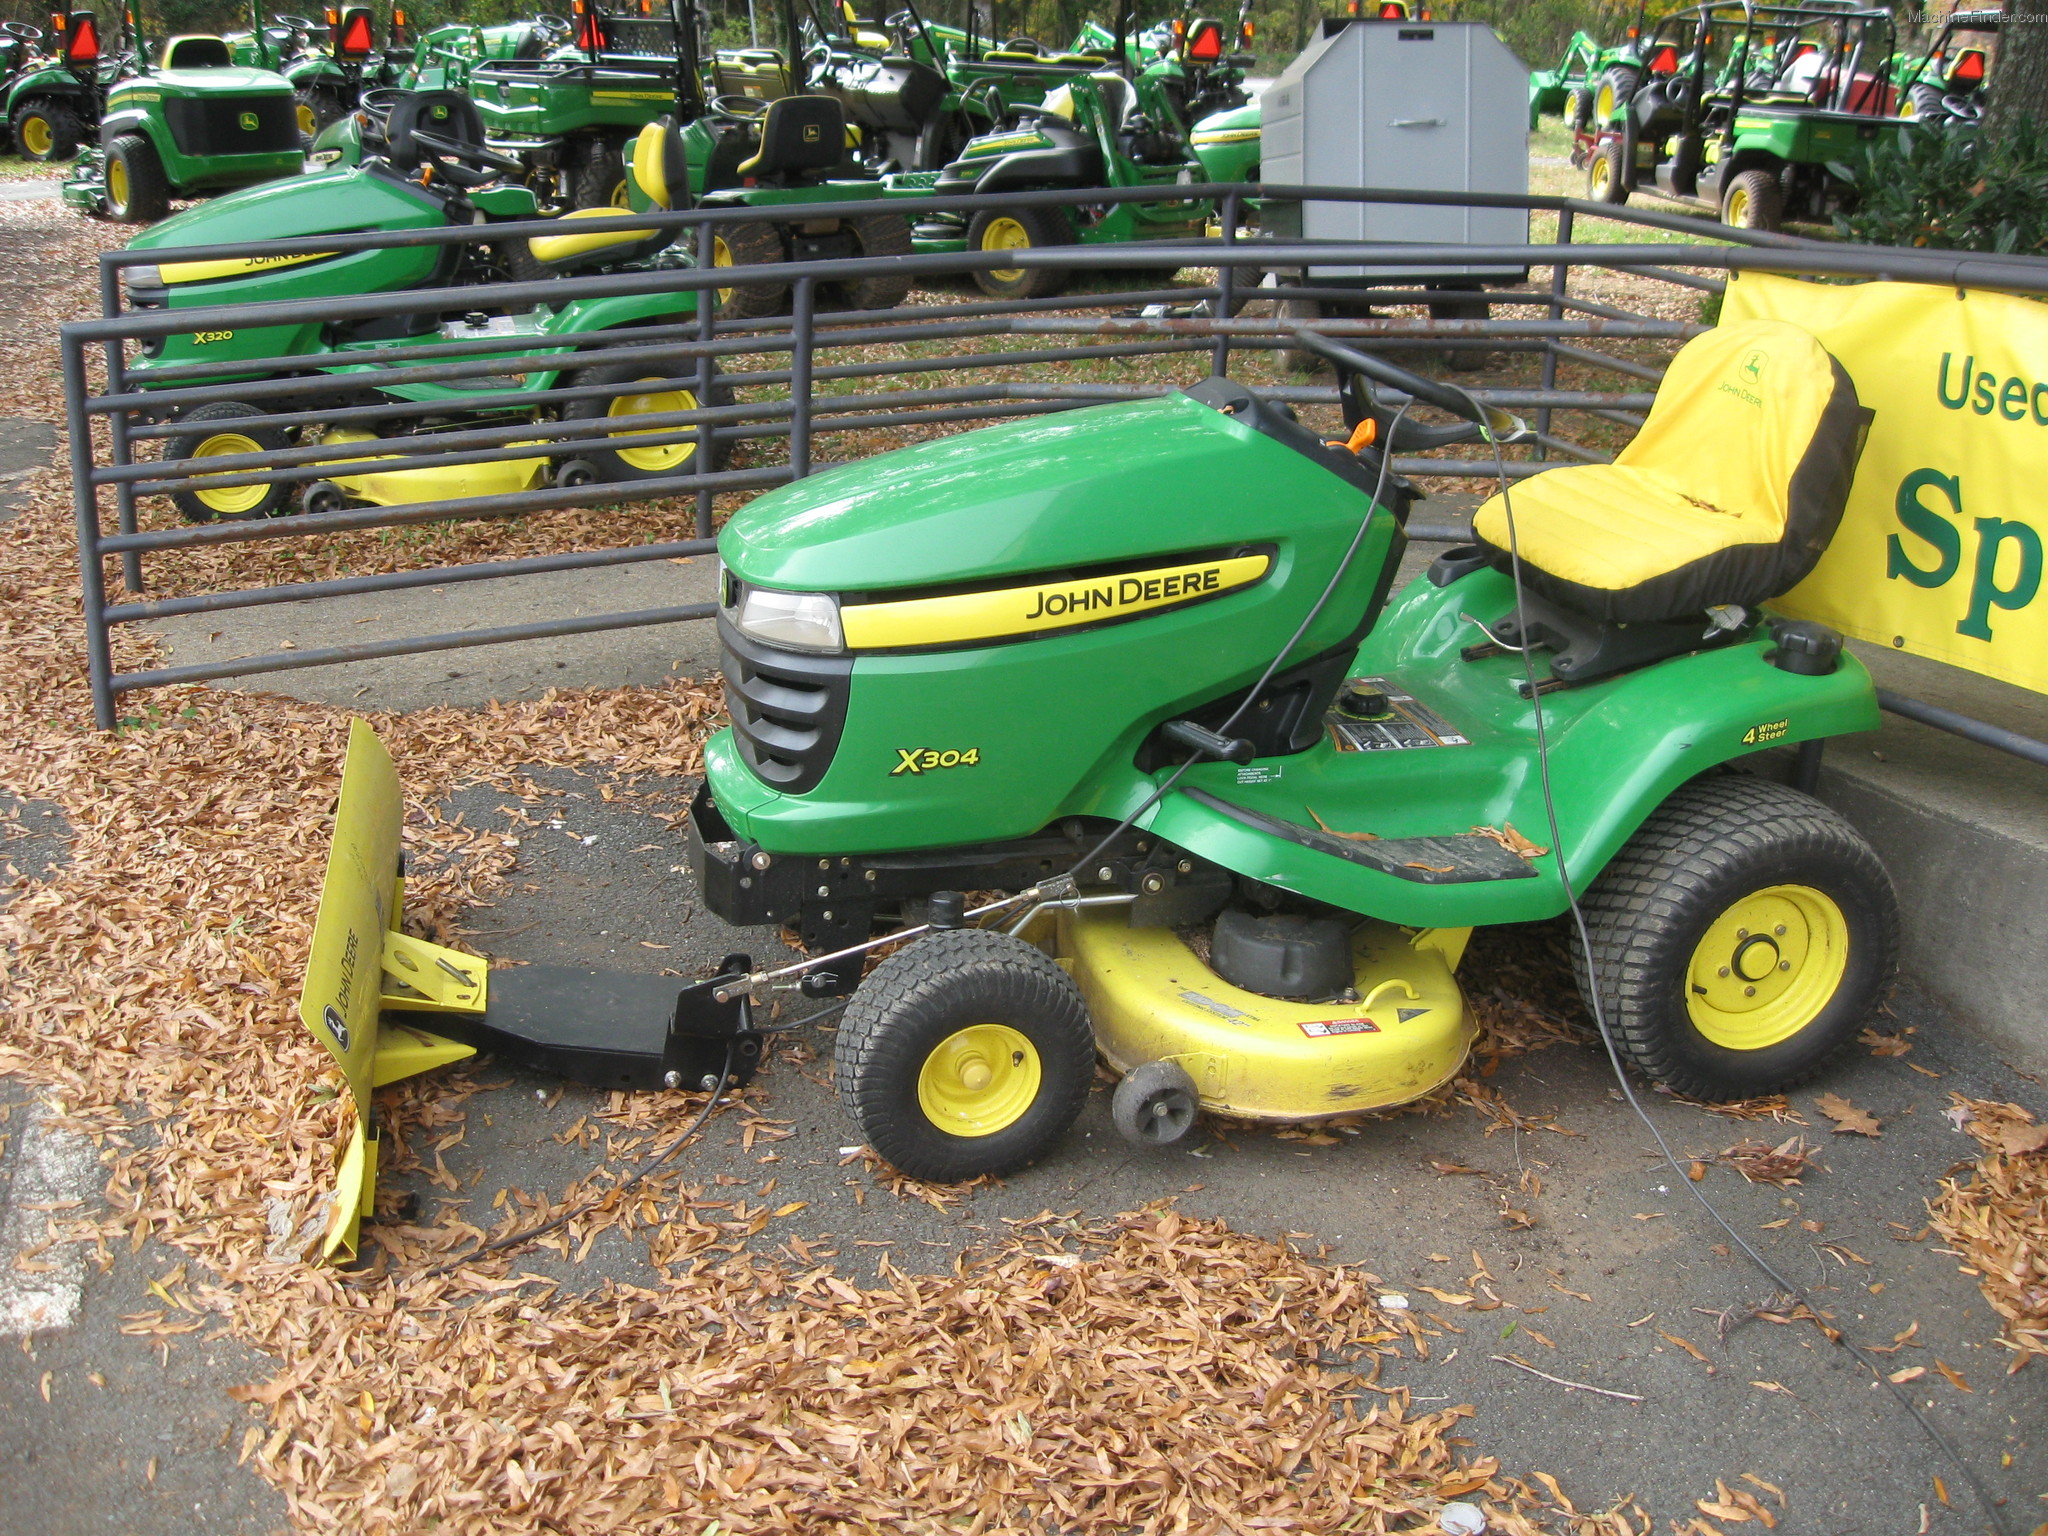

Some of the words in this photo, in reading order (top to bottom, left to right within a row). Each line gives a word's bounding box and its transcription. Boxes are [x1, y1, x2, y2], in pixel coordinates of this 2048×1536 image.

[193, 330, 234, 345] X320
[1717, 381, 1740, 397] JOHN
[1887, 467, 2044, 642] Sp
[1026, 586, 1113, 619] JOHN
[1119, 568, 1220, 605] DEERE
[1741, 727, 1756, 745] 4
[1758, 718, 1788, 734] Wheel
[1757, 729, 1787, 742] Steer
[889, 747, 981, 776] X304
[341, 928, 359, 979] DEERE
[335, 974, 352, 1019] JOHN
